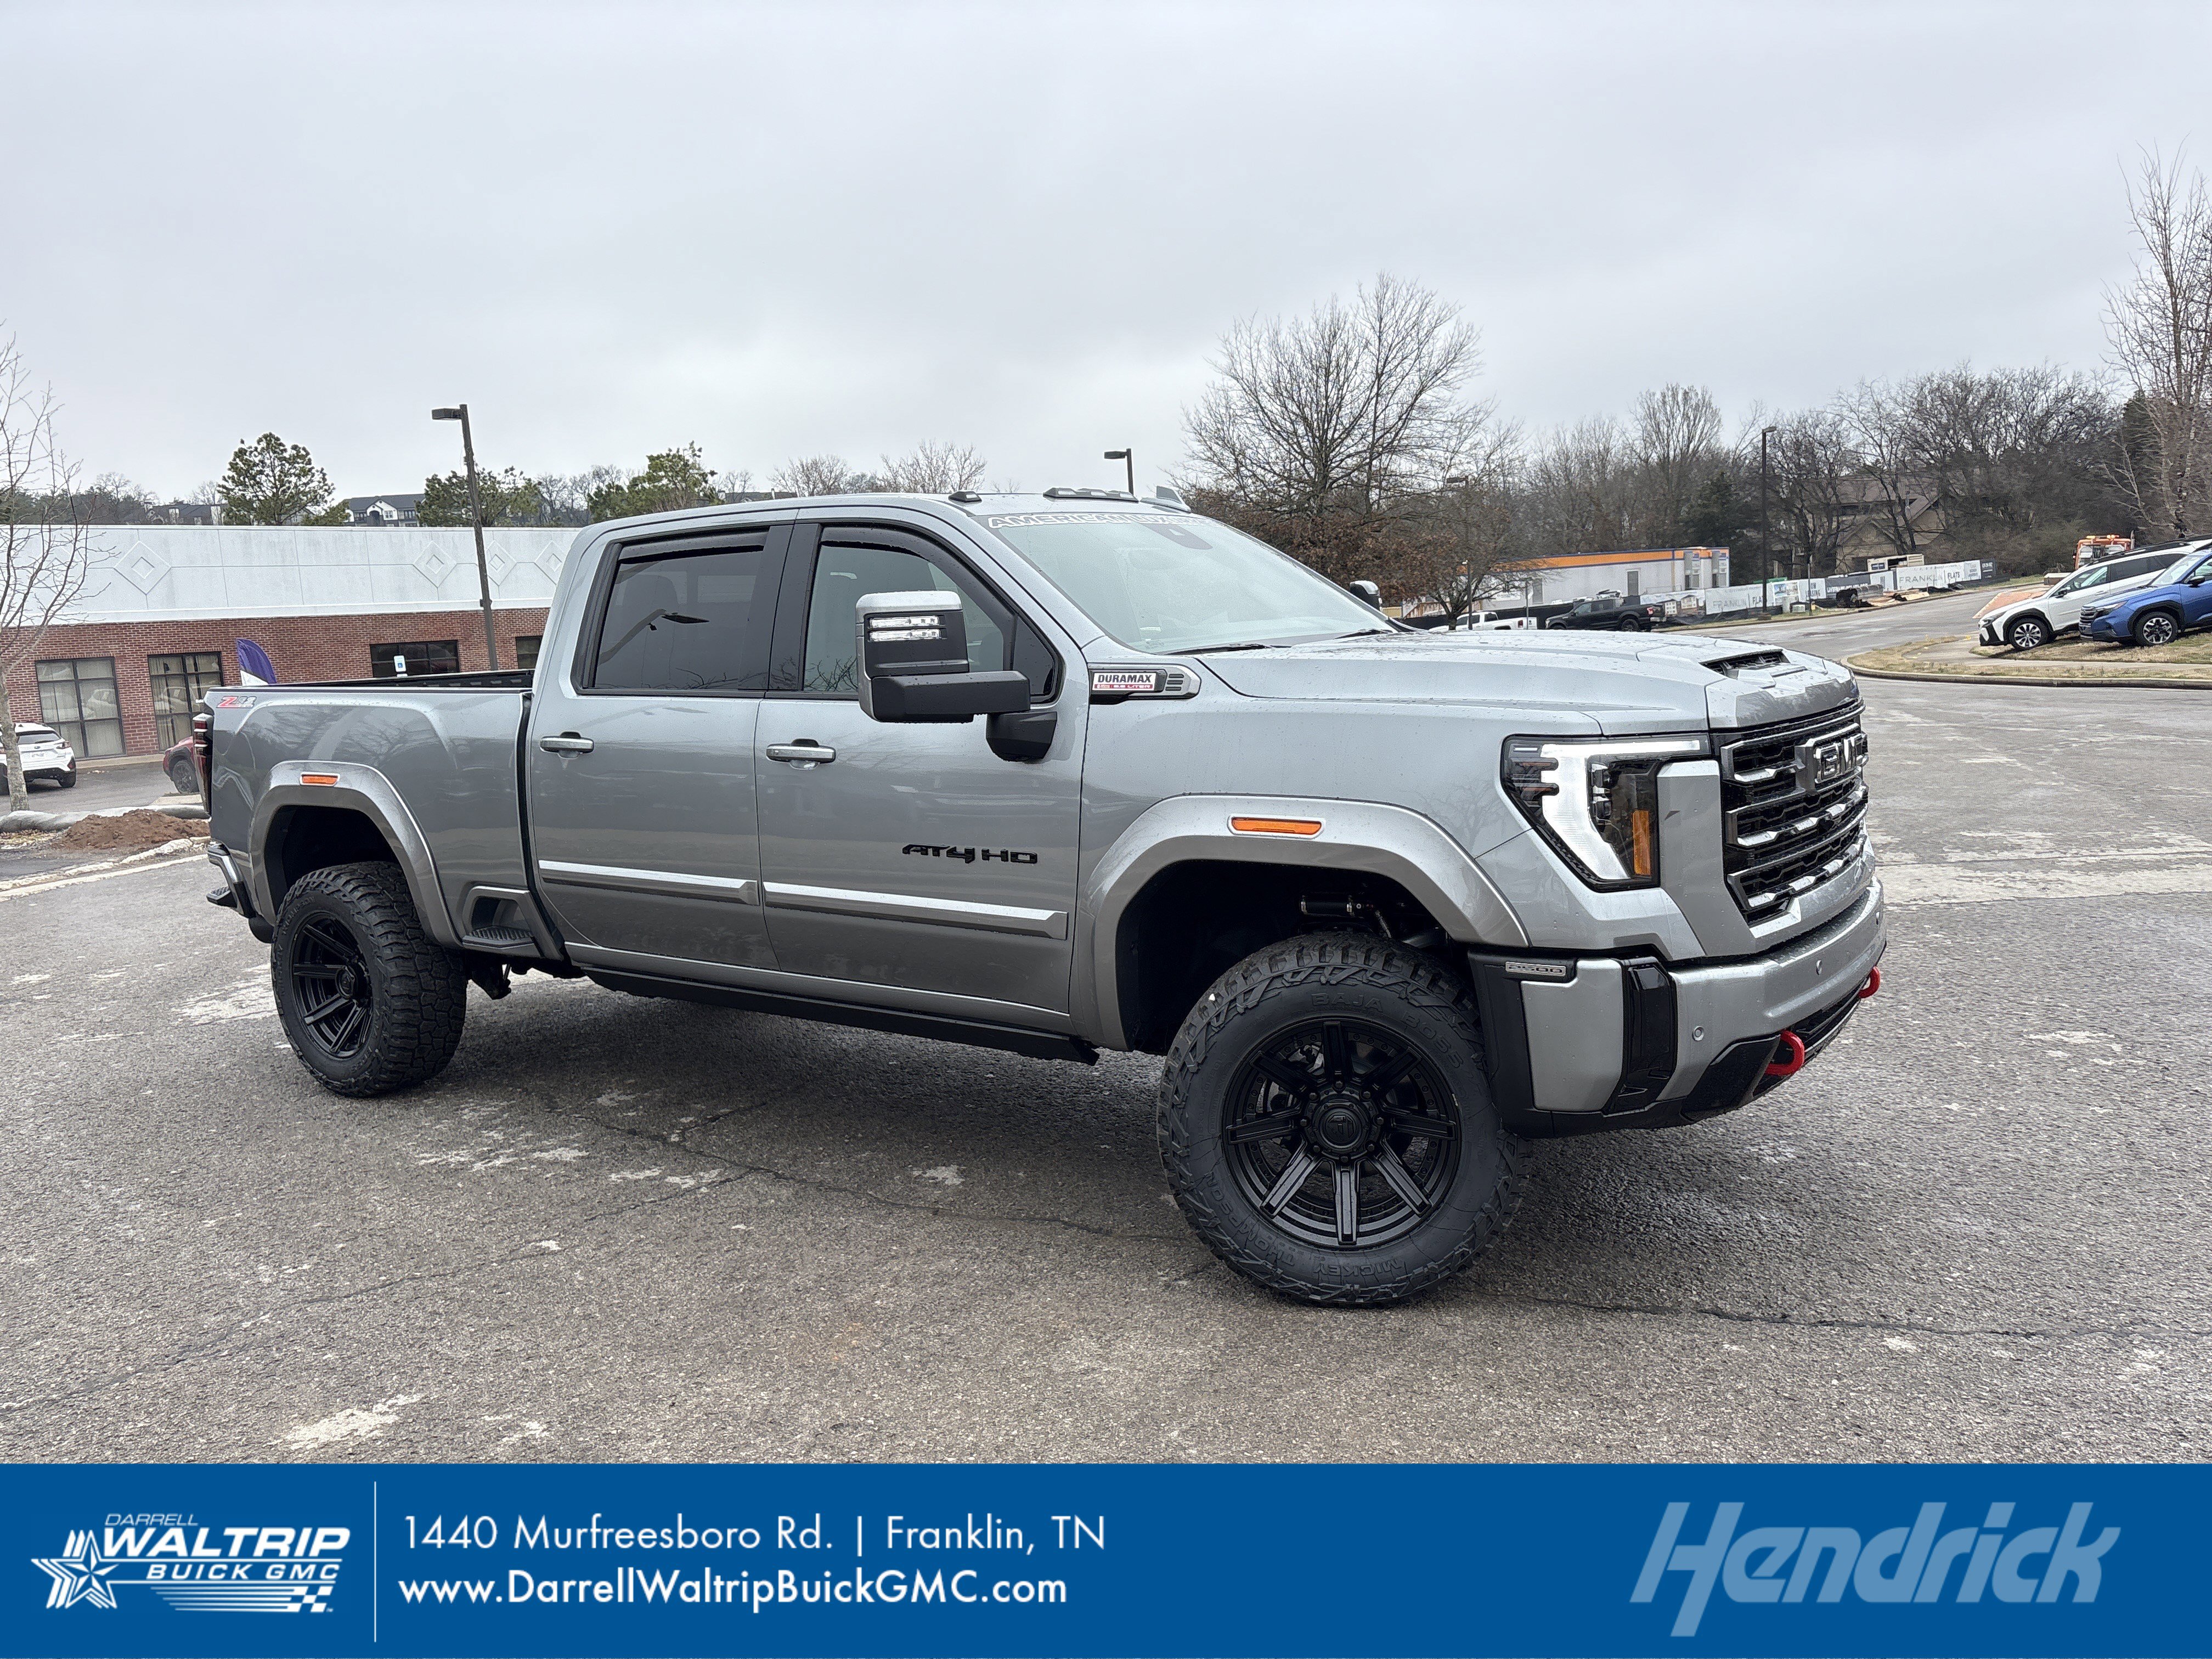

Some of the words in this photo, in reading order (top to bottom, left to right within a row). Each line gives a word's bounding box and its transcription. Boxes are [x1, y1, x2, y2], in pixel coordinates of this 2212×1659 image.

[988, 514, 1132, 528] AMERICAN
[1947, 571, 1960, 579] FLATS
[1752, 596, 1763, 605] FLA
[1097, 674, 1153, 684] DURAMAX
[902, 843, 975, 864] AT4
[981, 848, 1038, 864] HD
[1508, 965, 1563, 974] 2500
[1311, 992, 1384, 1012] BAJA
[1401, 1011, 1464, 1068] BOSS
[1205, 1171, 1295, 1267] THOMPSON
[1313, 1259, 1402, 1277] MICKEY
